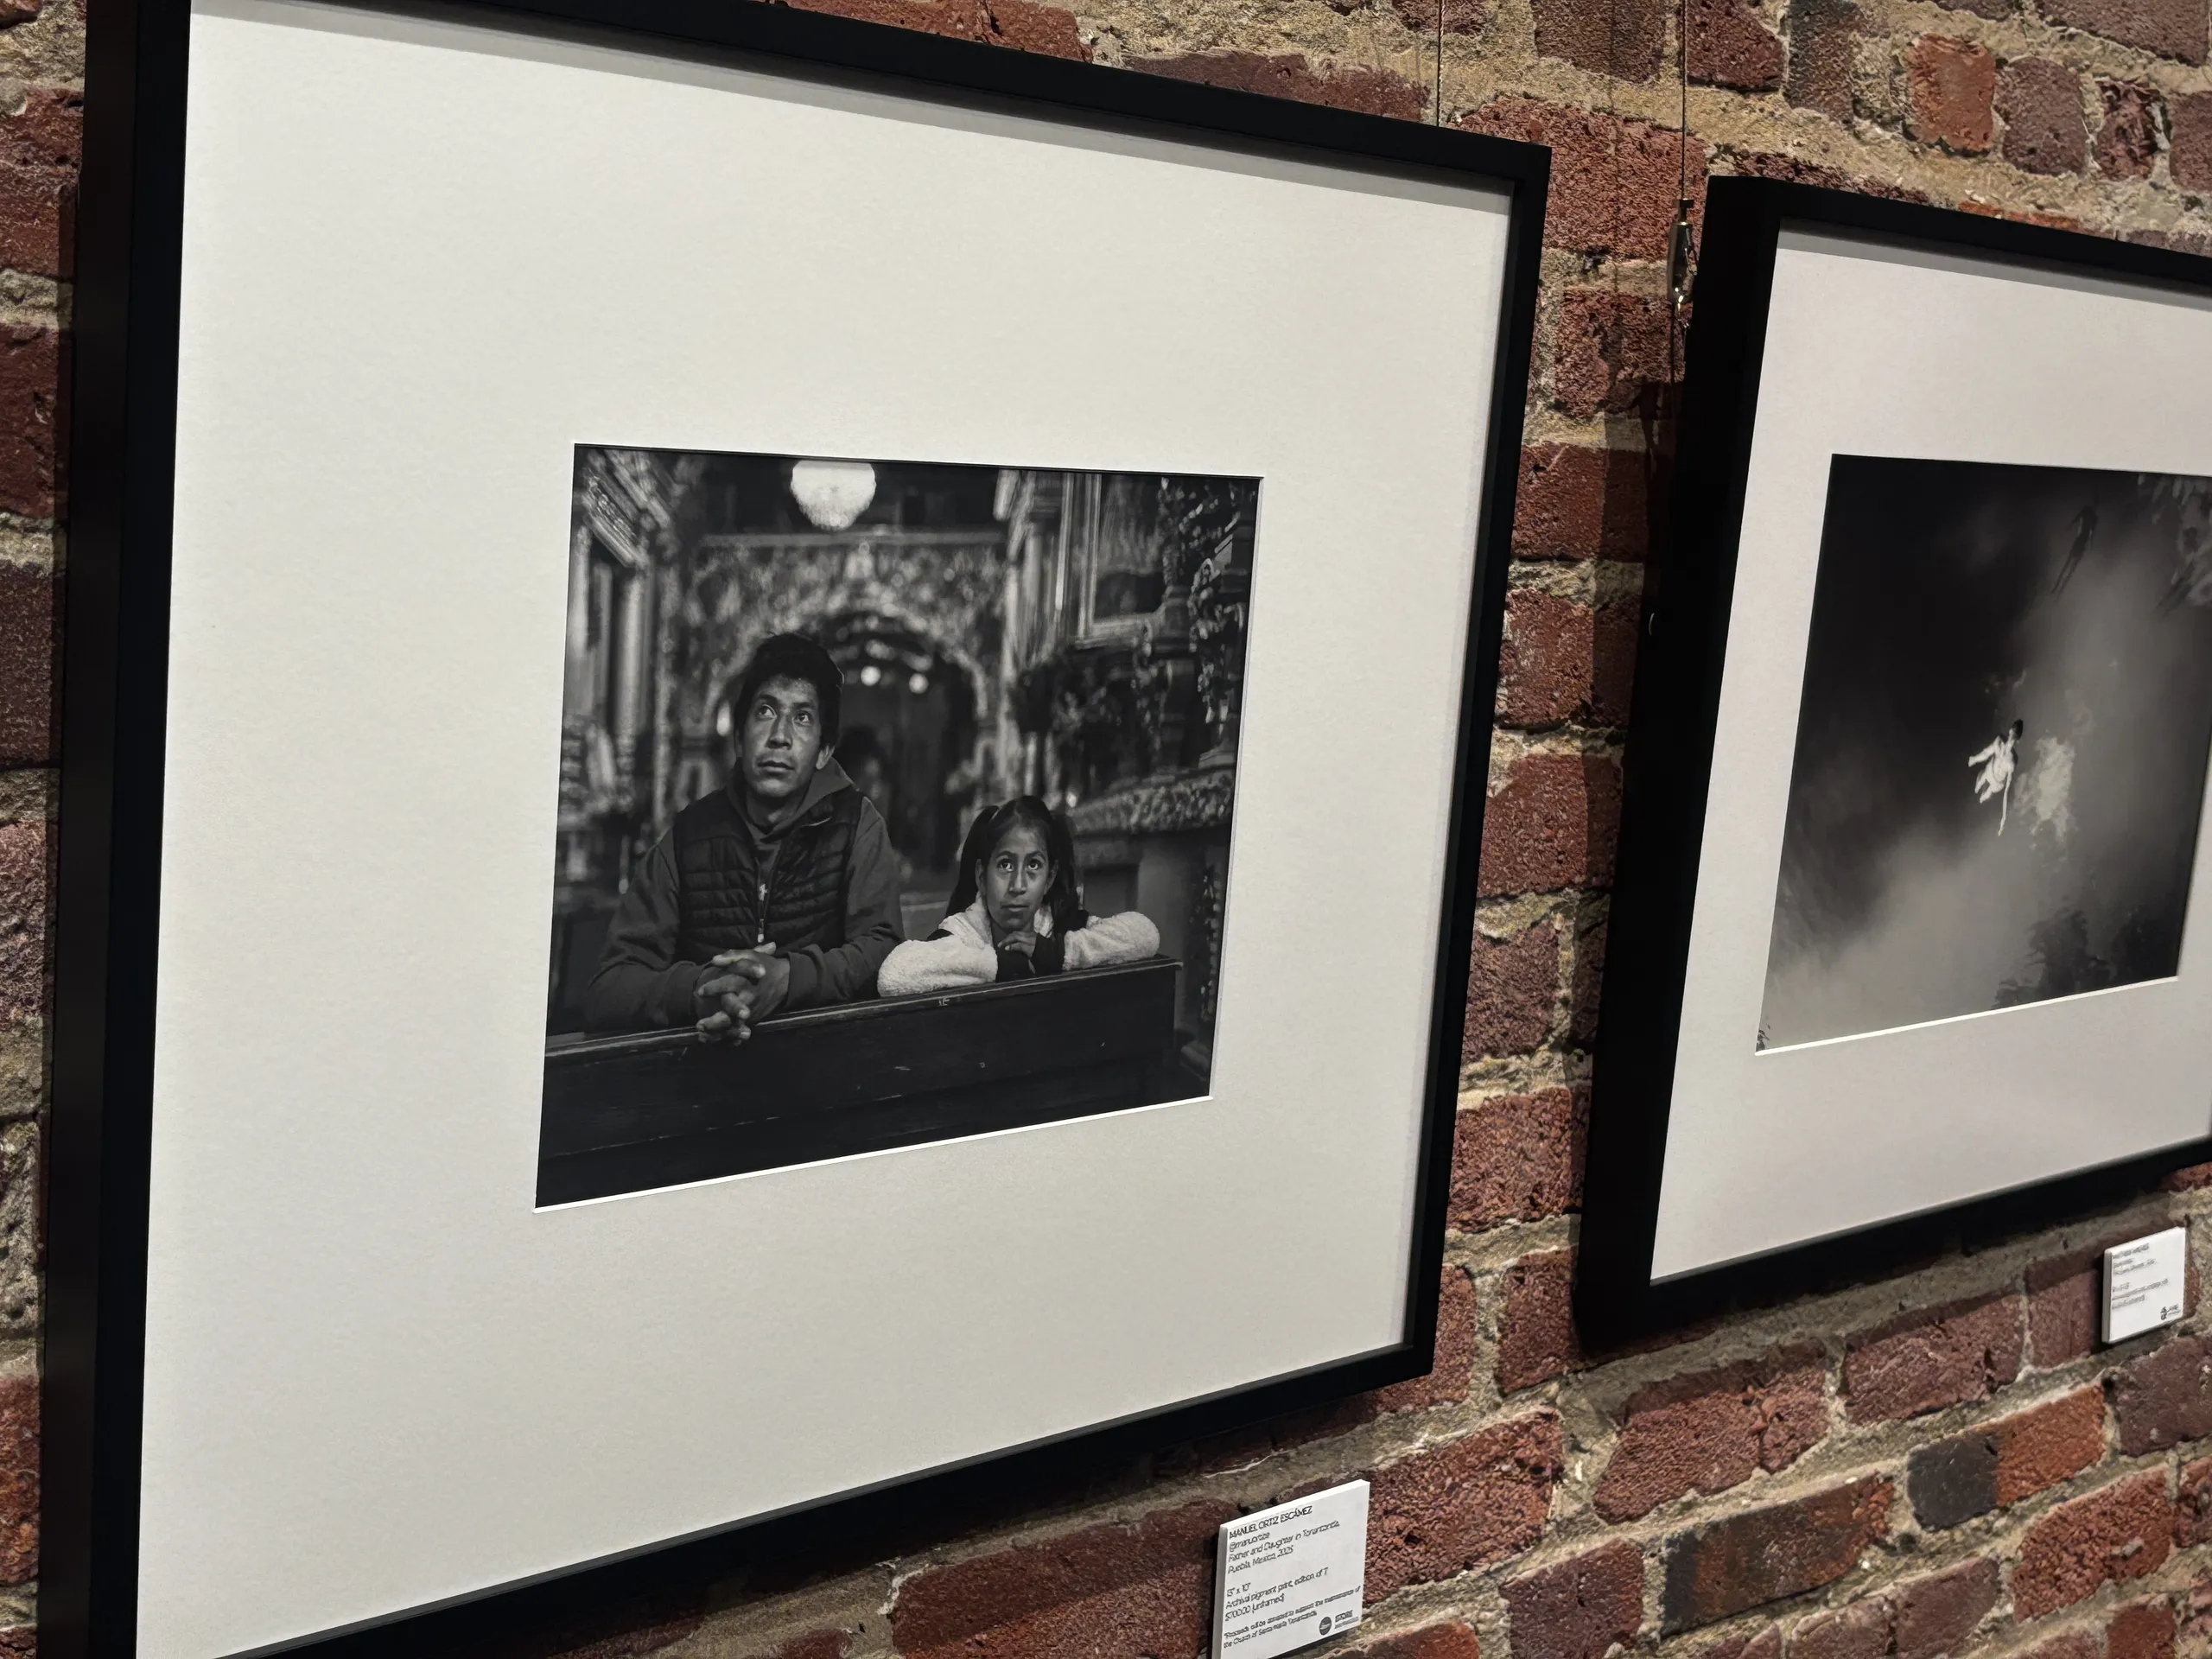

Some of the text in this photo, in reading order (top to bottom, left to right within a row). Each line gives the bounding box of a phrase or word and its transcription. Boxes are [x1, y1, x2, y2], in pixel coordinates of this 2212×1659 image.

[1230, 1524, 1257, 1538] MANUEL
[1258, 1516, 1279, 1529] ORTIZ
[1228, 1550, 1249, 1563] Father
[1250, 1545, 1263, 1555] and
[1264, 1535, 1294, 1552] Daughter
